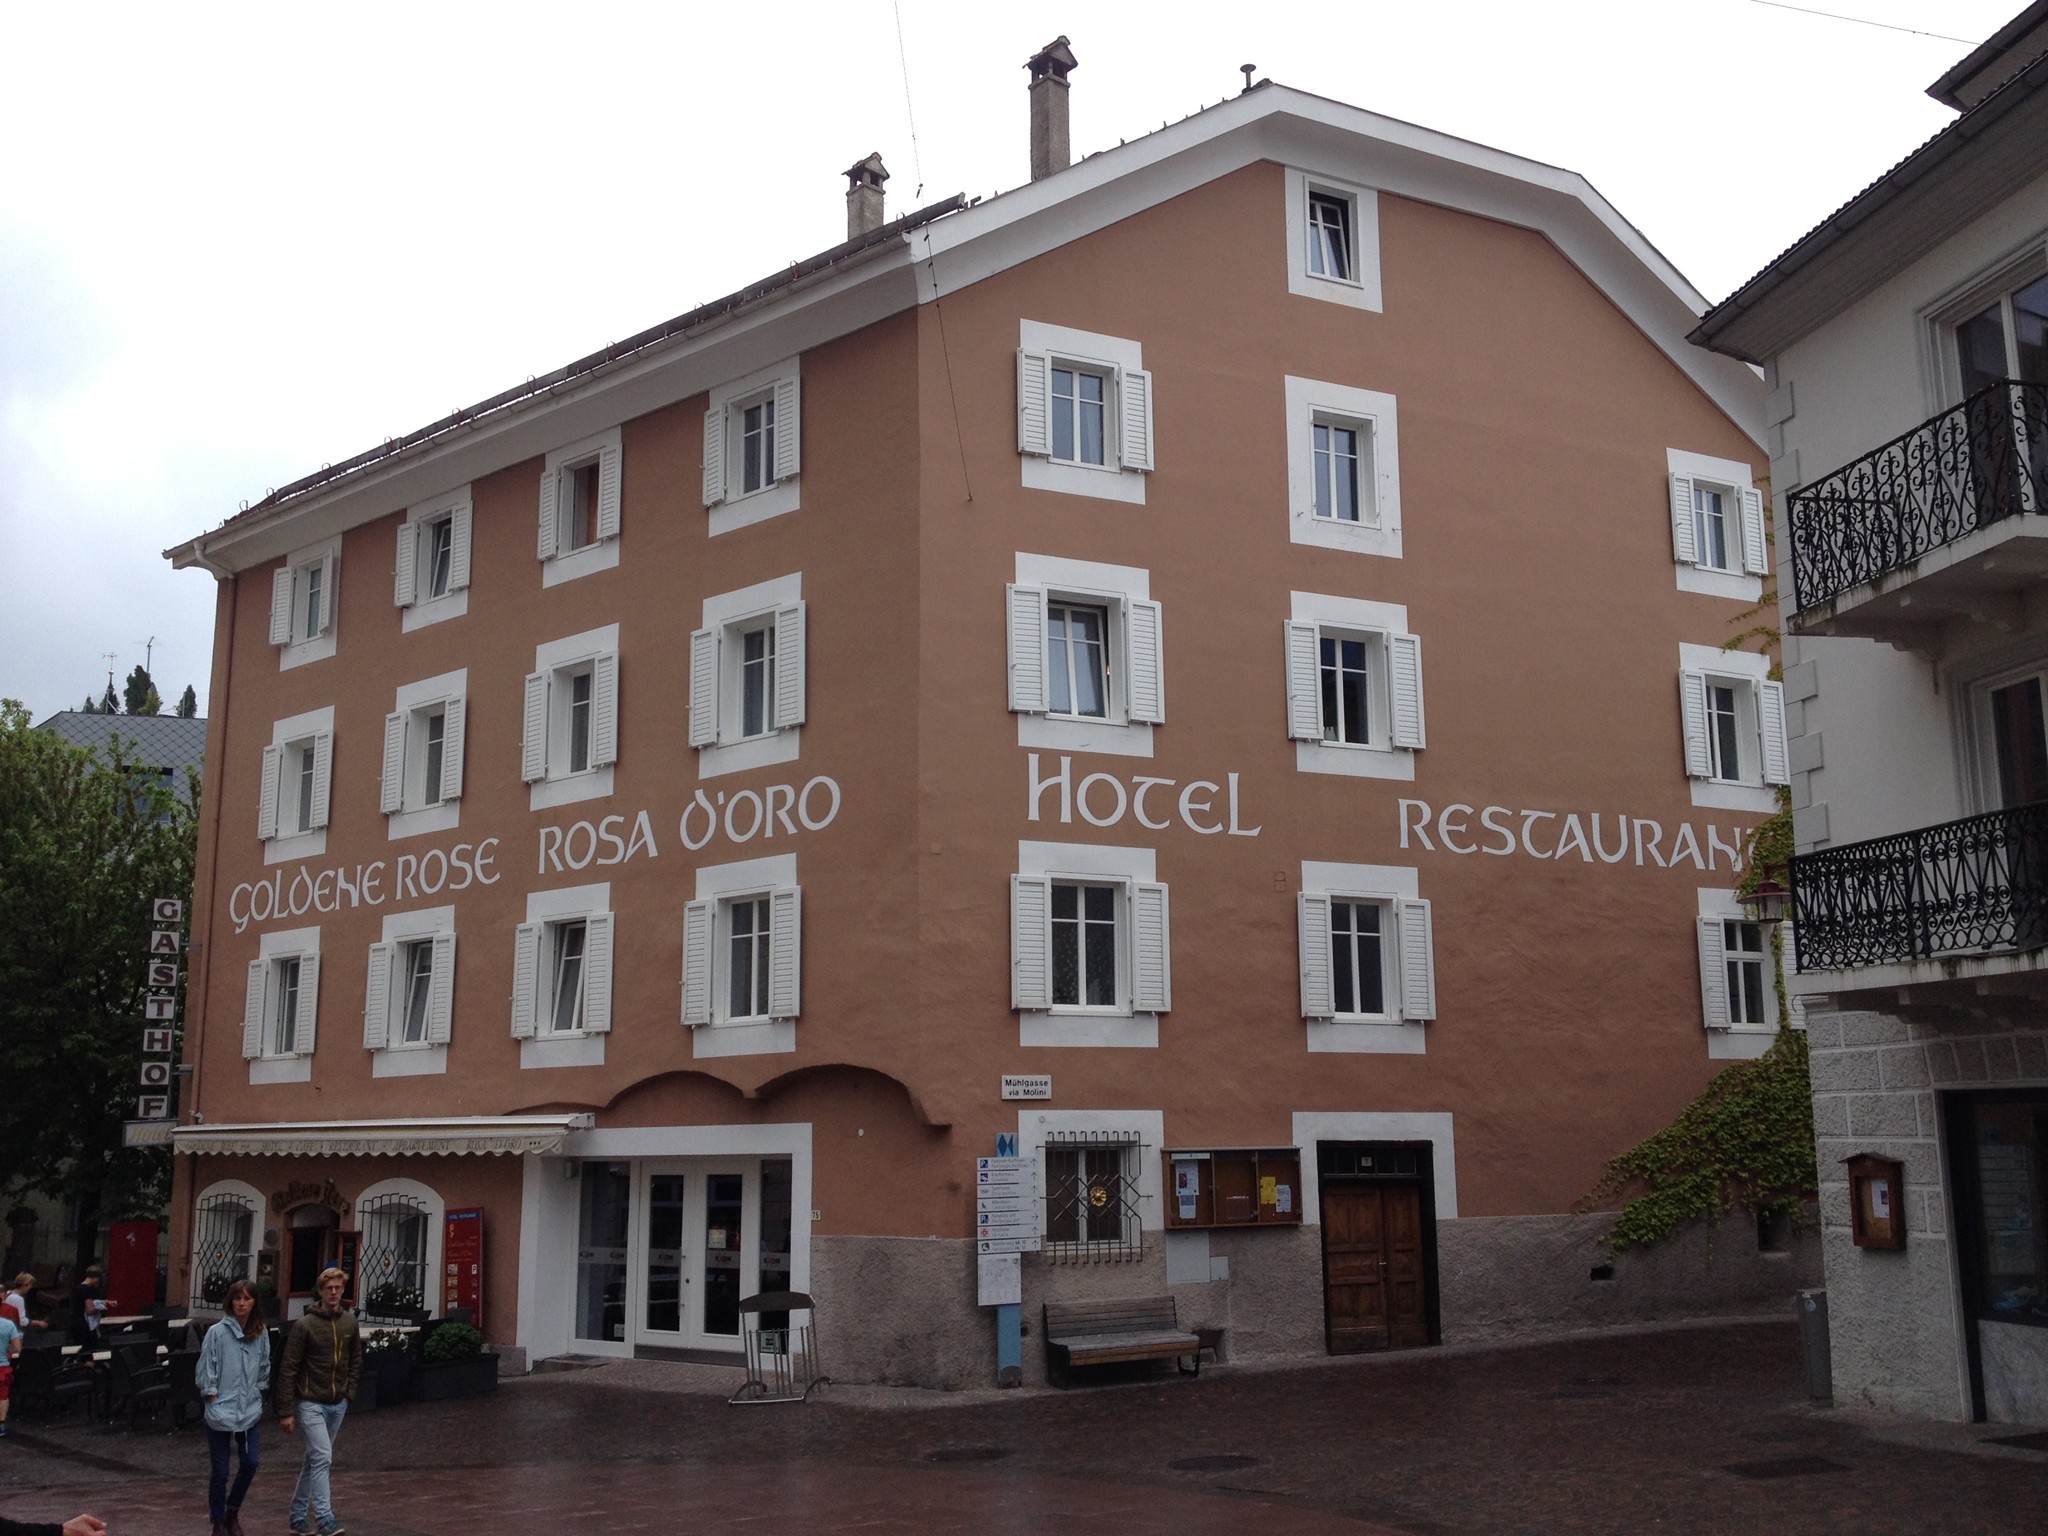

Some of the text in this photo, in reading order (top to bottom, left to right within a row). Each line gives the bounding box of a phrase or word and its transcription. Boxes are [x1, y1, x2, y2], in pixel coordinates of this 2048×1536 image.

[538, 809, 659, 874] ROSA
[229, 838, 501, 933] GOLDENE ROSE
[142, 901, 179, 1116] GASTHOF
[1005, 1079, 1048, 1088] Mühlgasse
